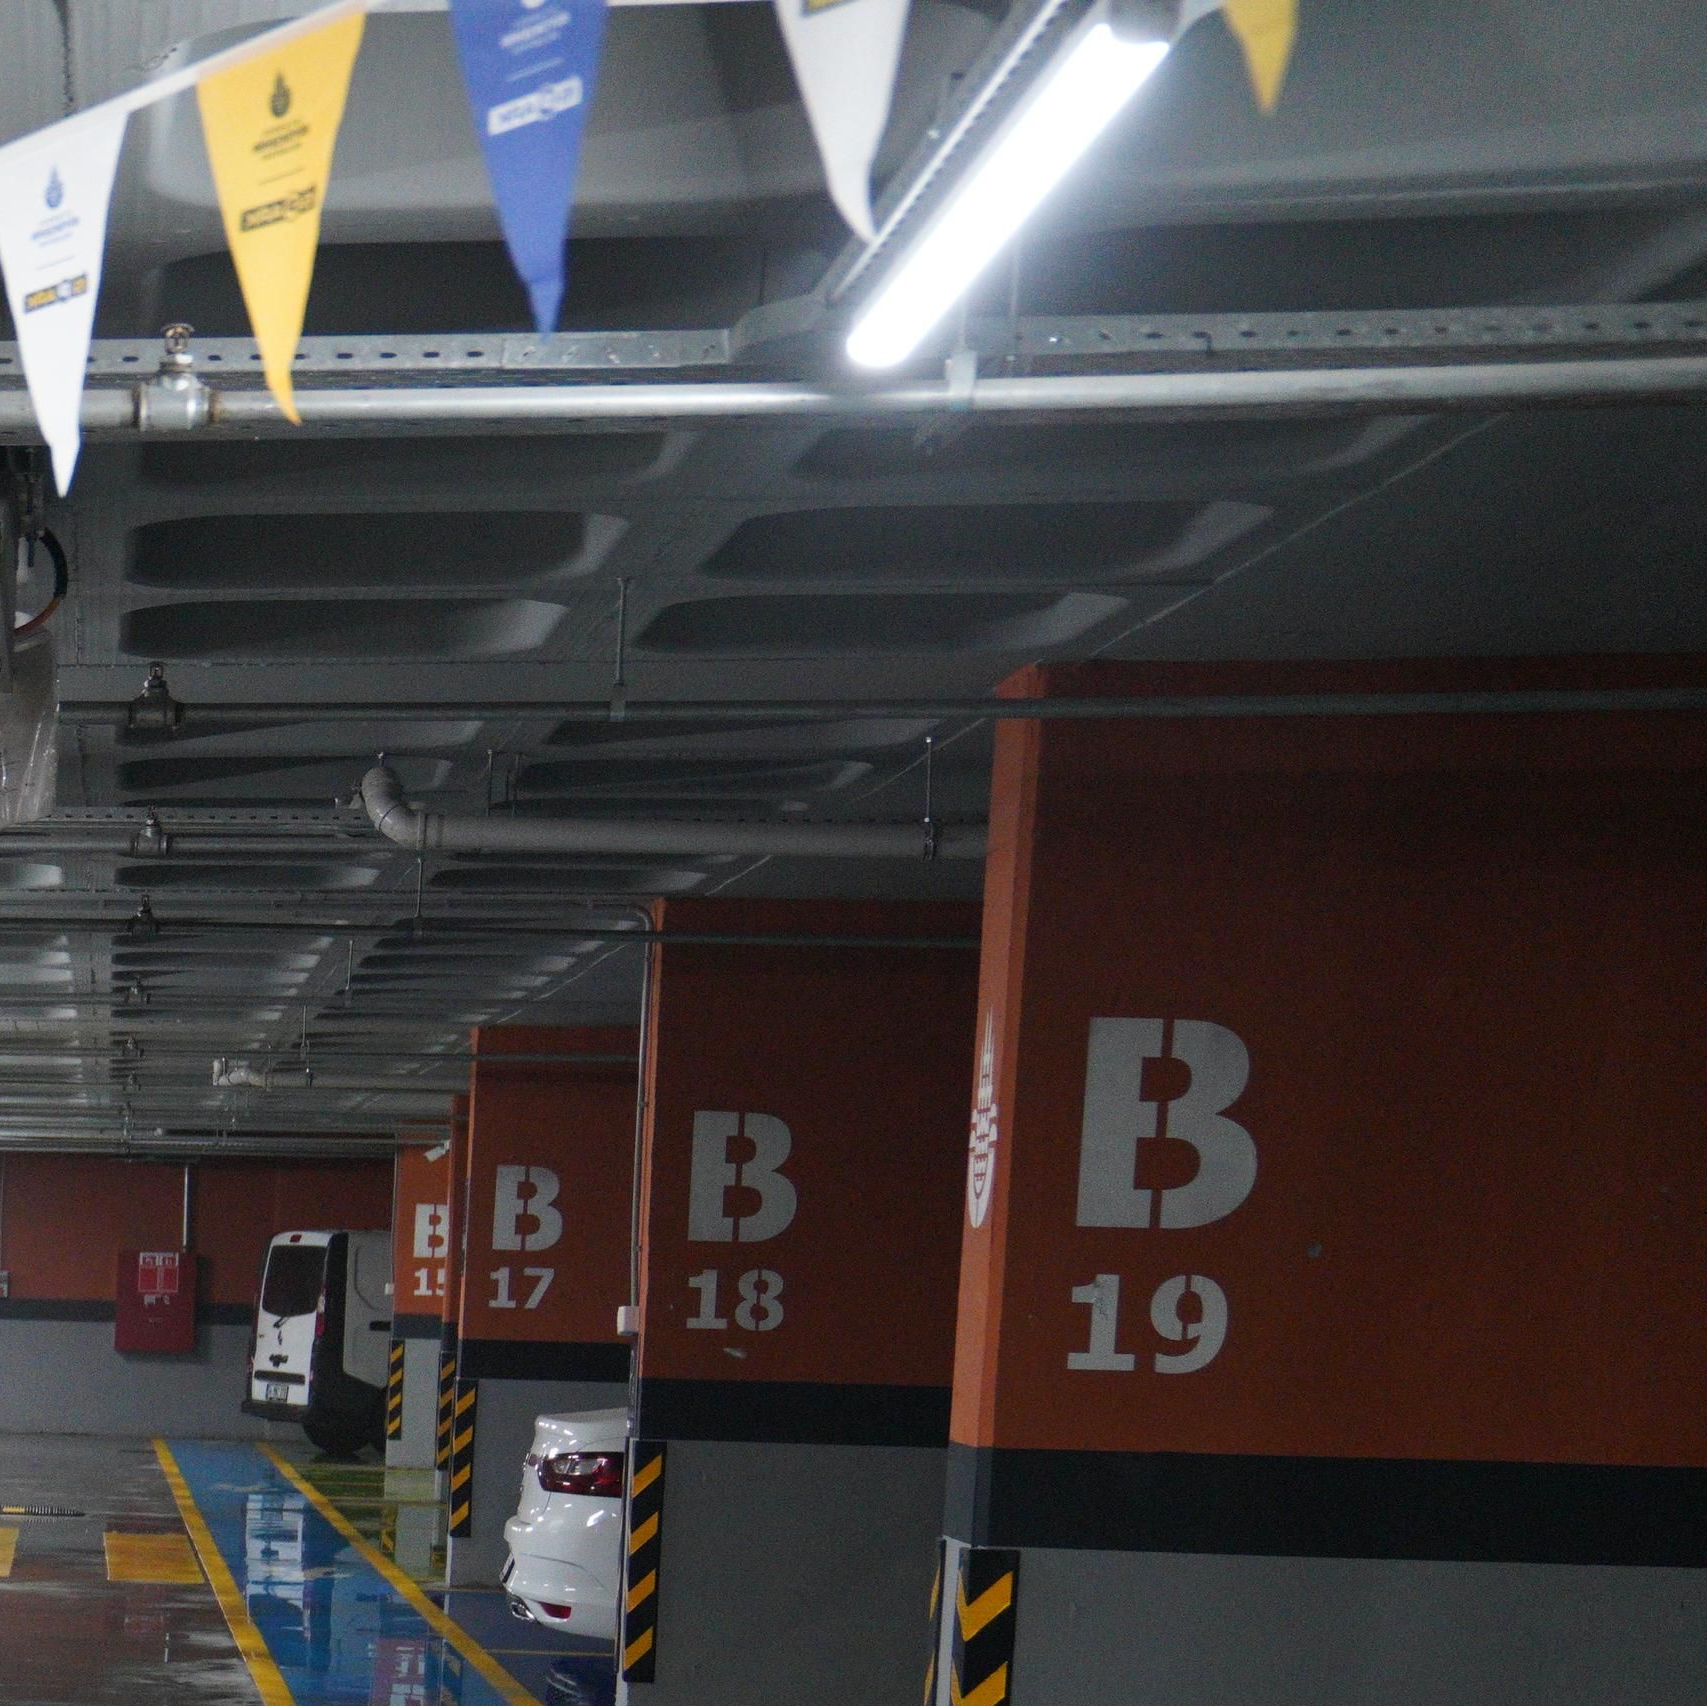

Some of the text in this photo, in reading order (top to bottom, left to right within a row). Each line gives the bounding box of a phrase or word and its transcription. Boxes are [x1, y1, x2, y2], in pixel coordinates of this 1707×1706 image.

[1076, 1017, 1258, 1229] B
[492, 1165, 563, 1251] B
[688, 1111, 797, 1242] B
[414, 1203, 449, 1258] B
[489, 1267, 554, 1308] 17
[687, 1270, 784, 1330] 18
[1067, 1274, 1228, 1374] 19
